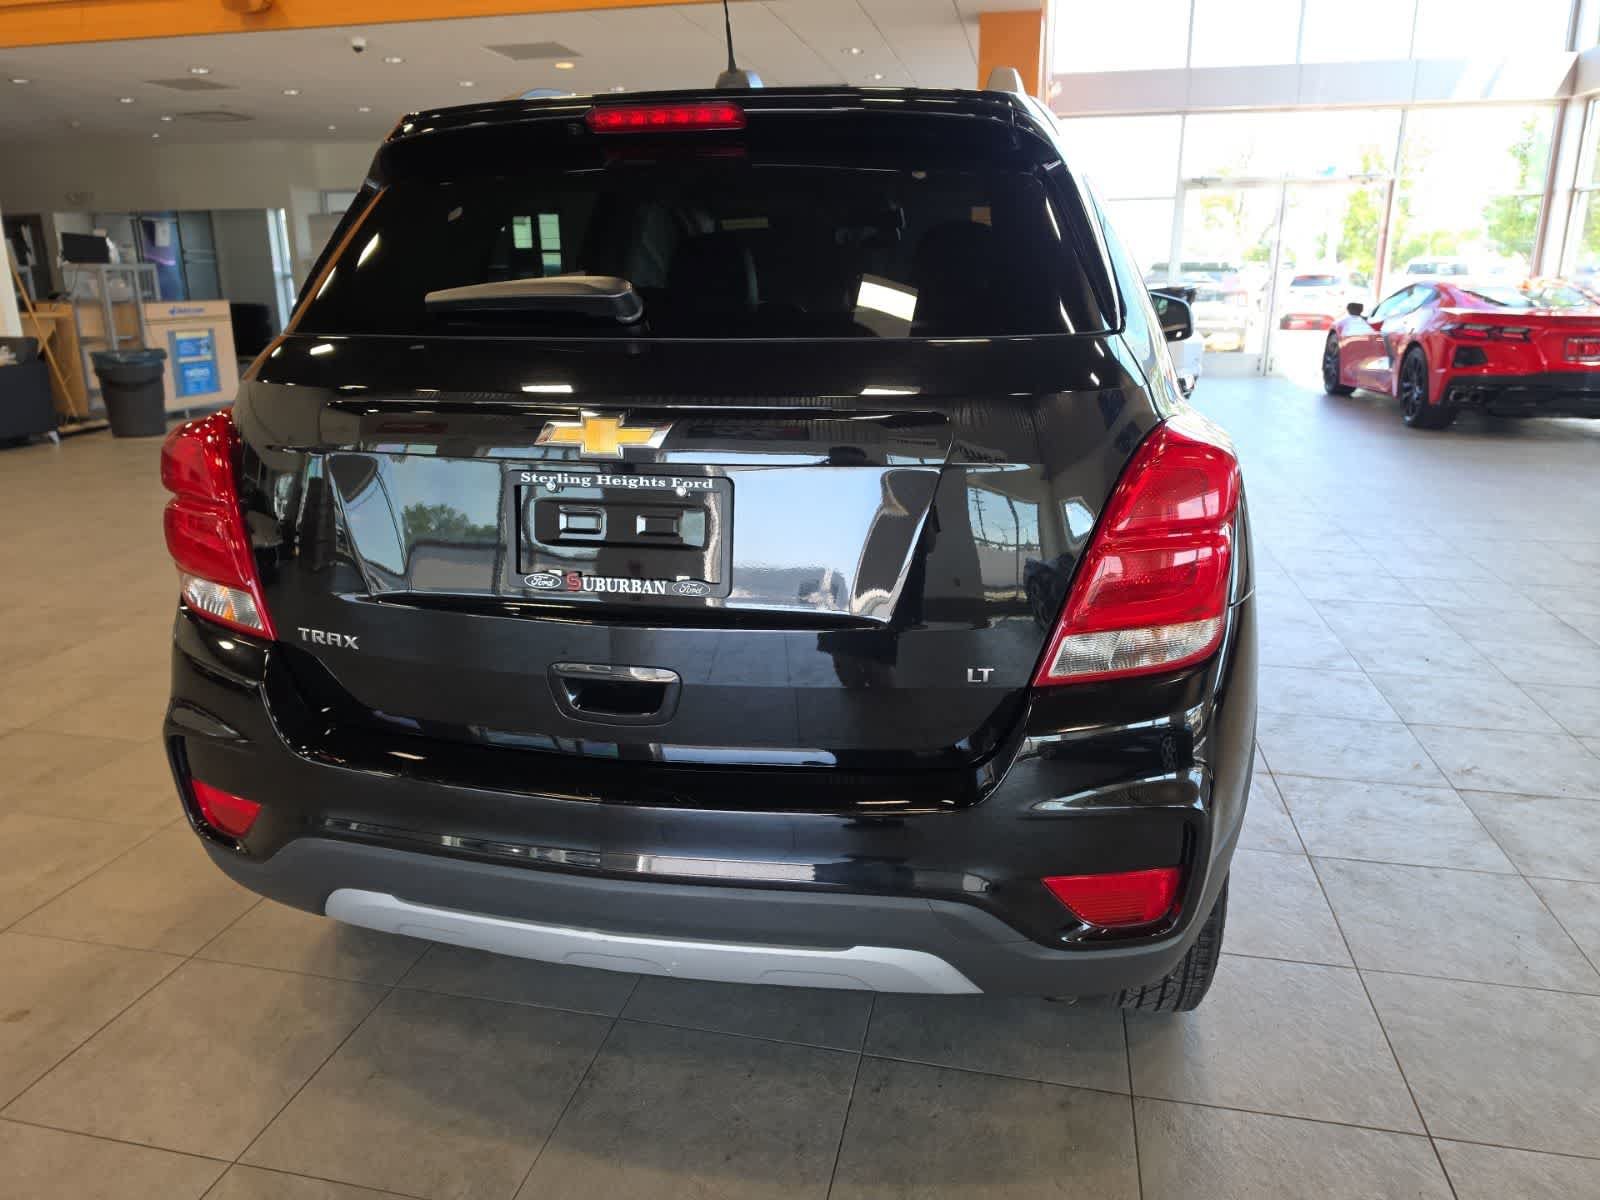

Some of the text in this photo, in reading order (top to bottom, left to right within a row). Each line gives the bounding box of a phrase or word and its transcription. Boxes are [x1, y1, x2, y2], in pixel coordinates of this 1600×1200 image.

[520, 471, 713, 489] Sterling Heights Ford
[566, 571, 667, 595] SUBURBAN
[297, 627, 360, 650] TRAX
[967, 667, 995, 683] LT
